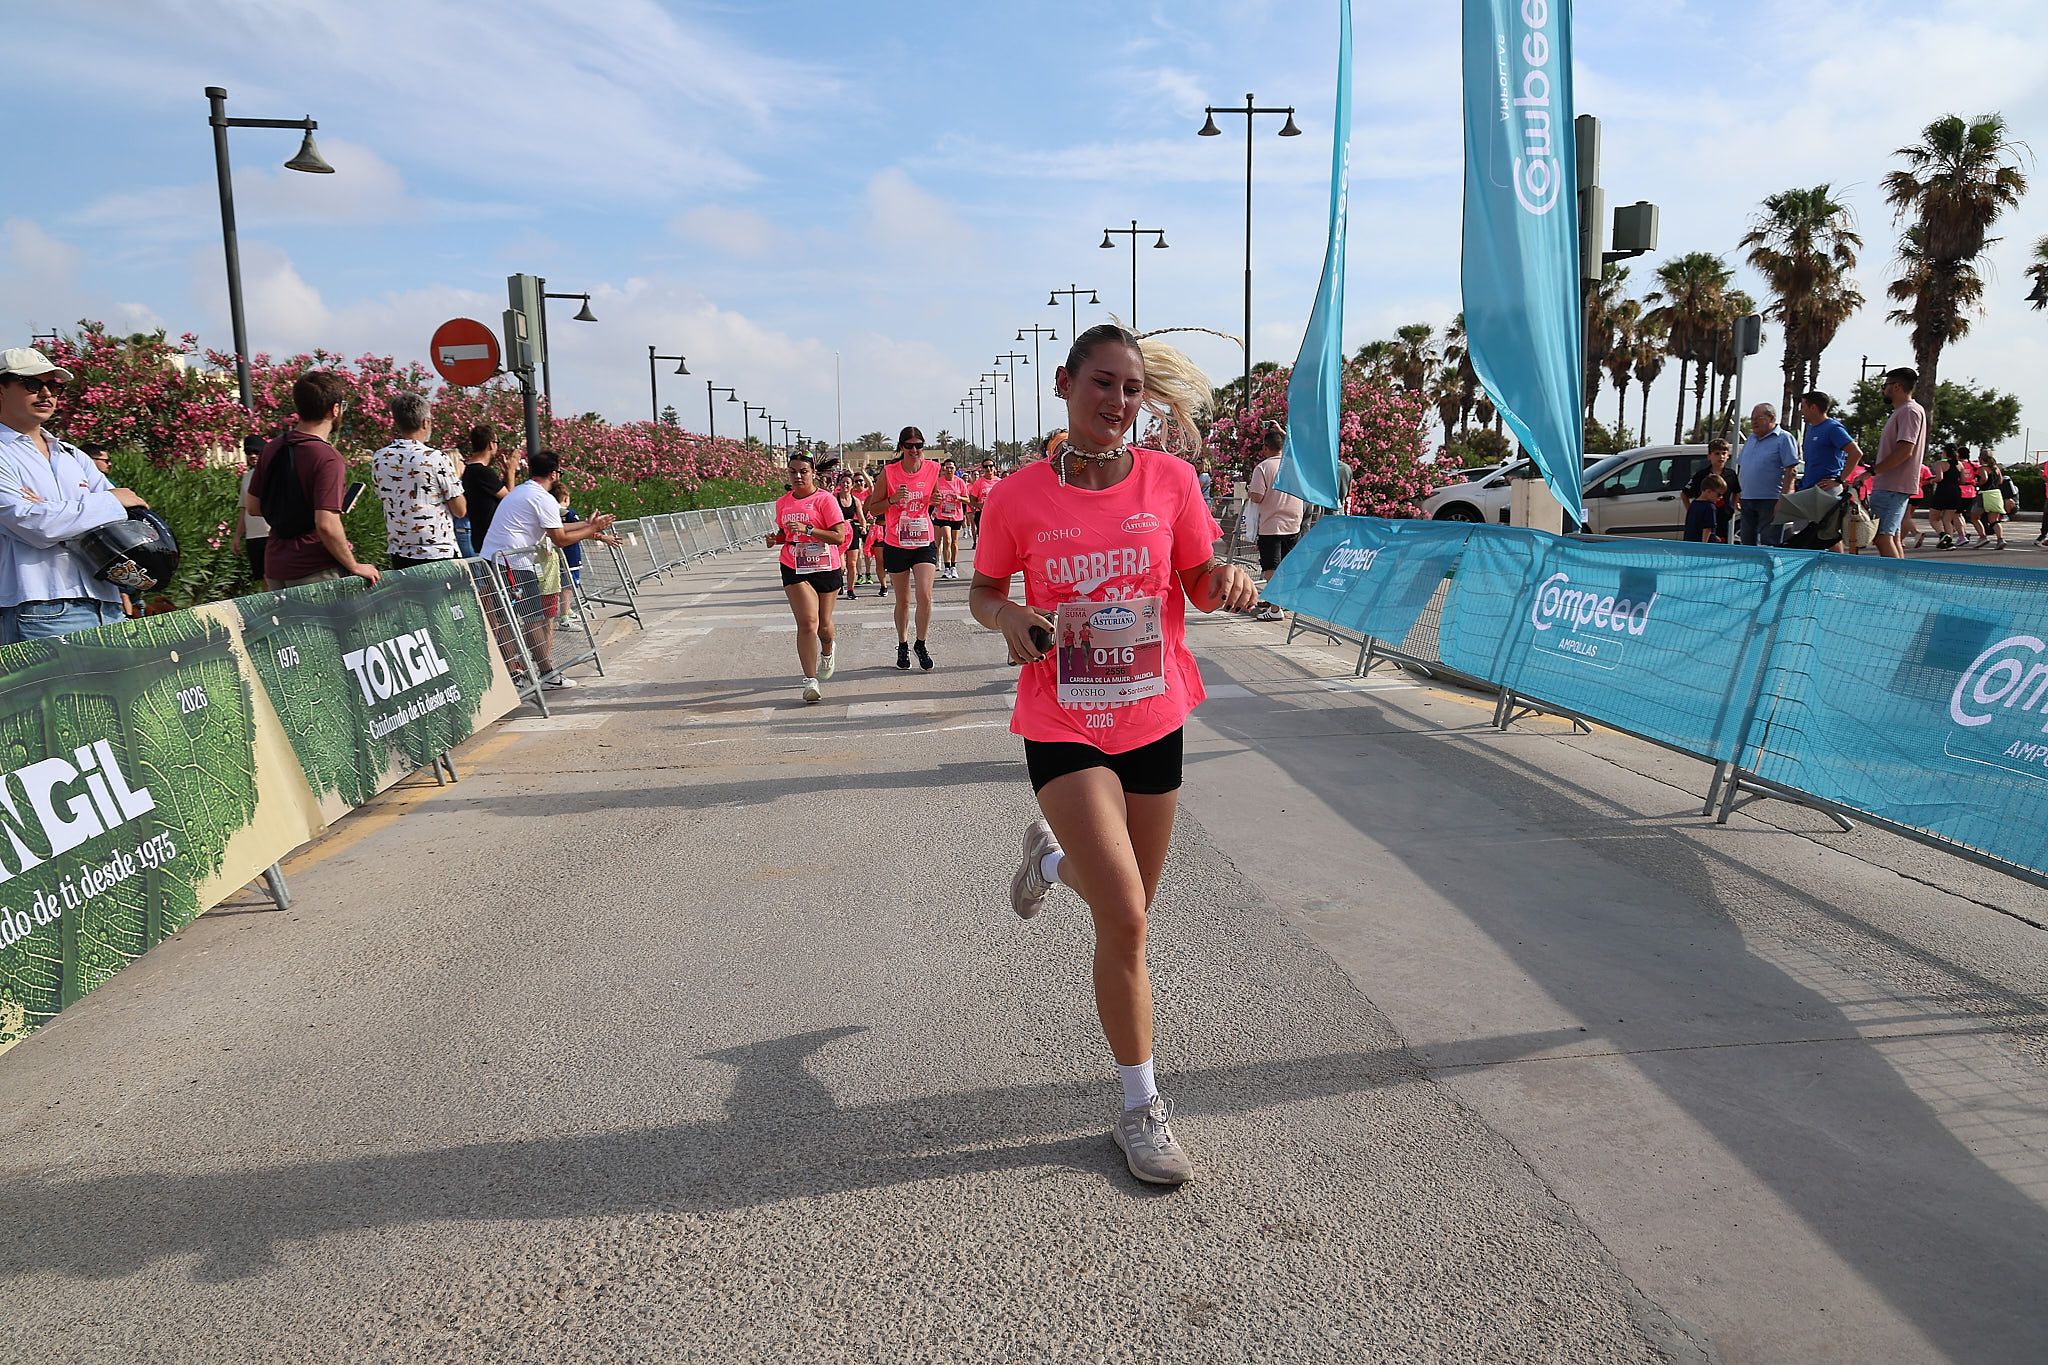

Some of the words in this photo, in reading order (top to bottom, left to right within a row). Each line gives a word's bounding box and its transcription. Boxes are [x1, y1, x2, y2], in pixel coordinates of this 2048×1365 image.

[1037, 527, 1081, 542] OYSHO
[1045, 546, 1151, 584] CARRERA
[1532, 572, 1660, 635] Compeed
[1093, 616, 1133, 626] ASTURIANA
[277, 646, 299, 668] 1975
[1093, 647, 1135, 665] 016
[1558, 638, 1598, 657] AMPOLLAS
[1127, 684, 1154, 695] Santander
[176, 686, 208, 714] 2026
[369, 706, 409, 739] Cuidando
[407, 701, 420, 720] de
[416, 697, 427, 715] ti
[425, 688, 446, 711] desde
[444, 684, 461, 703] 1975
[1085, 712, 1114, 728] 2026
[33, 889, 61, 926] de
[59, 874, 82, 910] ti
[80, 849, 136, 899] desde
[135, 830, 176, 870] 1975
